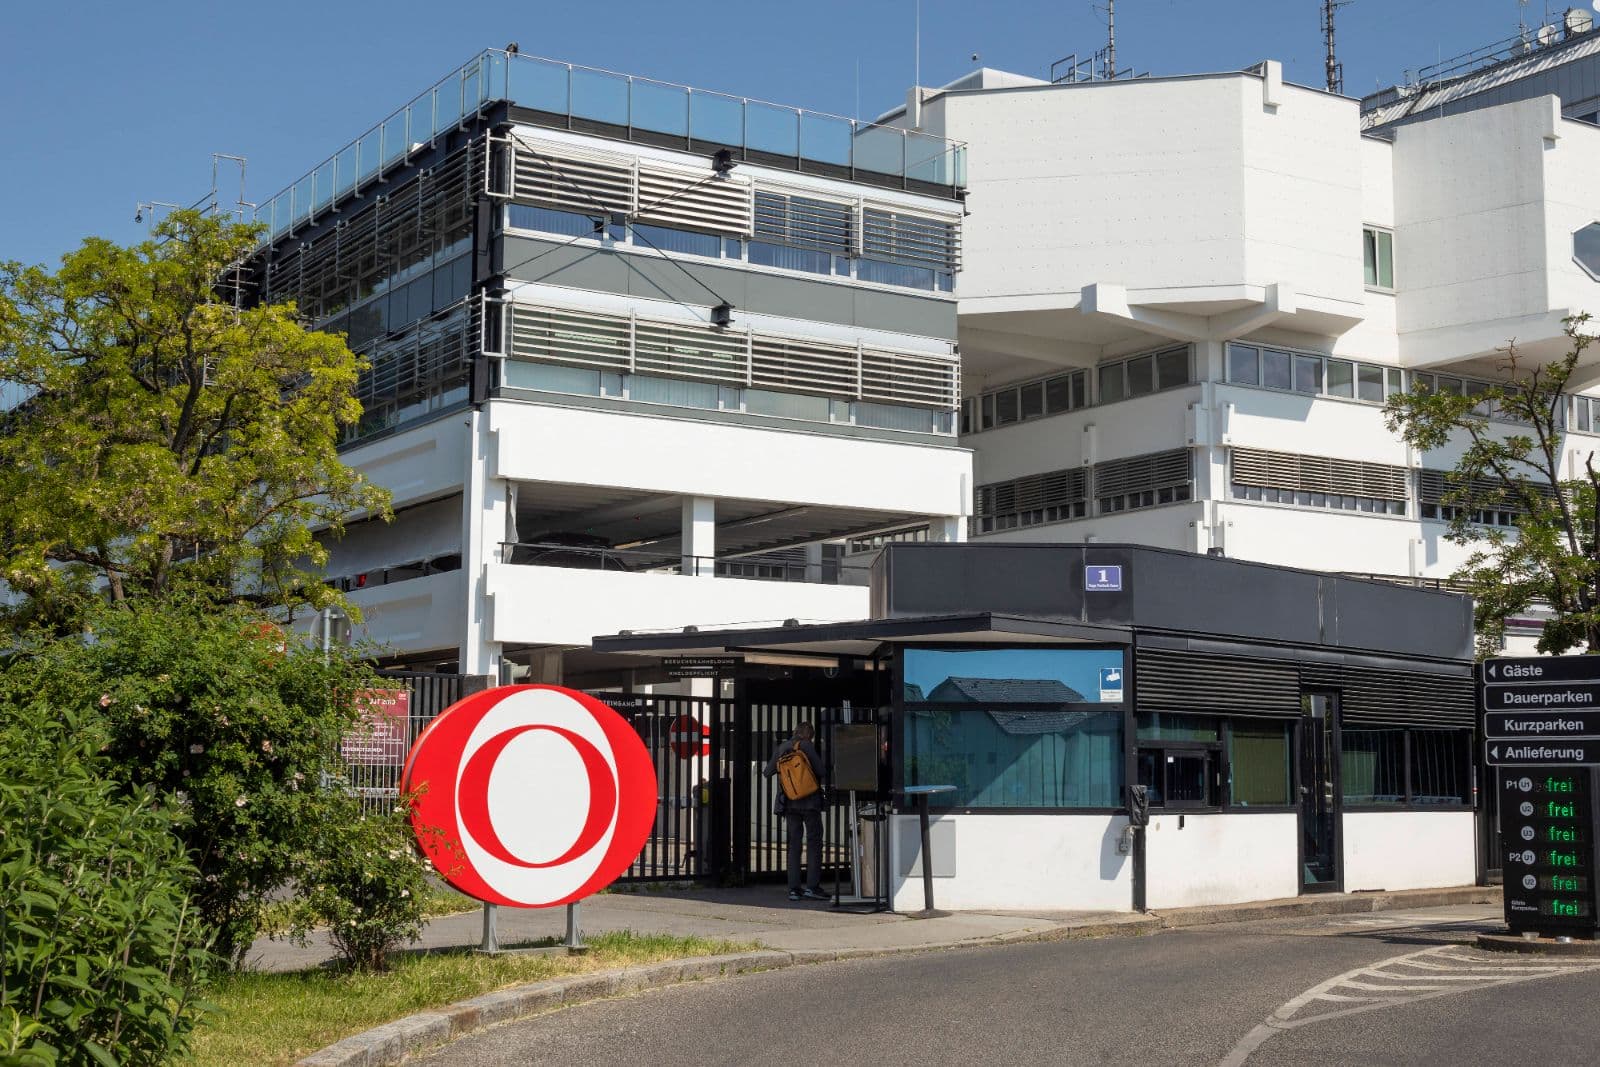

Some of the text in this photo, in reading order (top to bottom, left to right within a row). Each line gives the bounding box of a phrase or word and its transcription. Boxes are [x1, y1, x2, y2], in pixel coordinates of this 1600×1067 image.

[1098, 569, 1109, 582] 1
[1502, 664, 1543, 677] Gäste
[1503, 690, 1593, 706] Dauerparken
[1504, 718, 1584, 733] Kurzparken
[1505, 746, 1584, 761] Anlieferung
[1506, 780, 1518, 790] P1
[1546, 777, 1573, 792] frei
[1548, 801, 1574, 817] frei
[1549, 826, 1575, 841] frei
[1509, 852, 1521, 862] P2
[1550, 850, 1577, 866] frei
[1552, 874, 1577, 890] frei
[1552, 899, 1578, 916] frei
